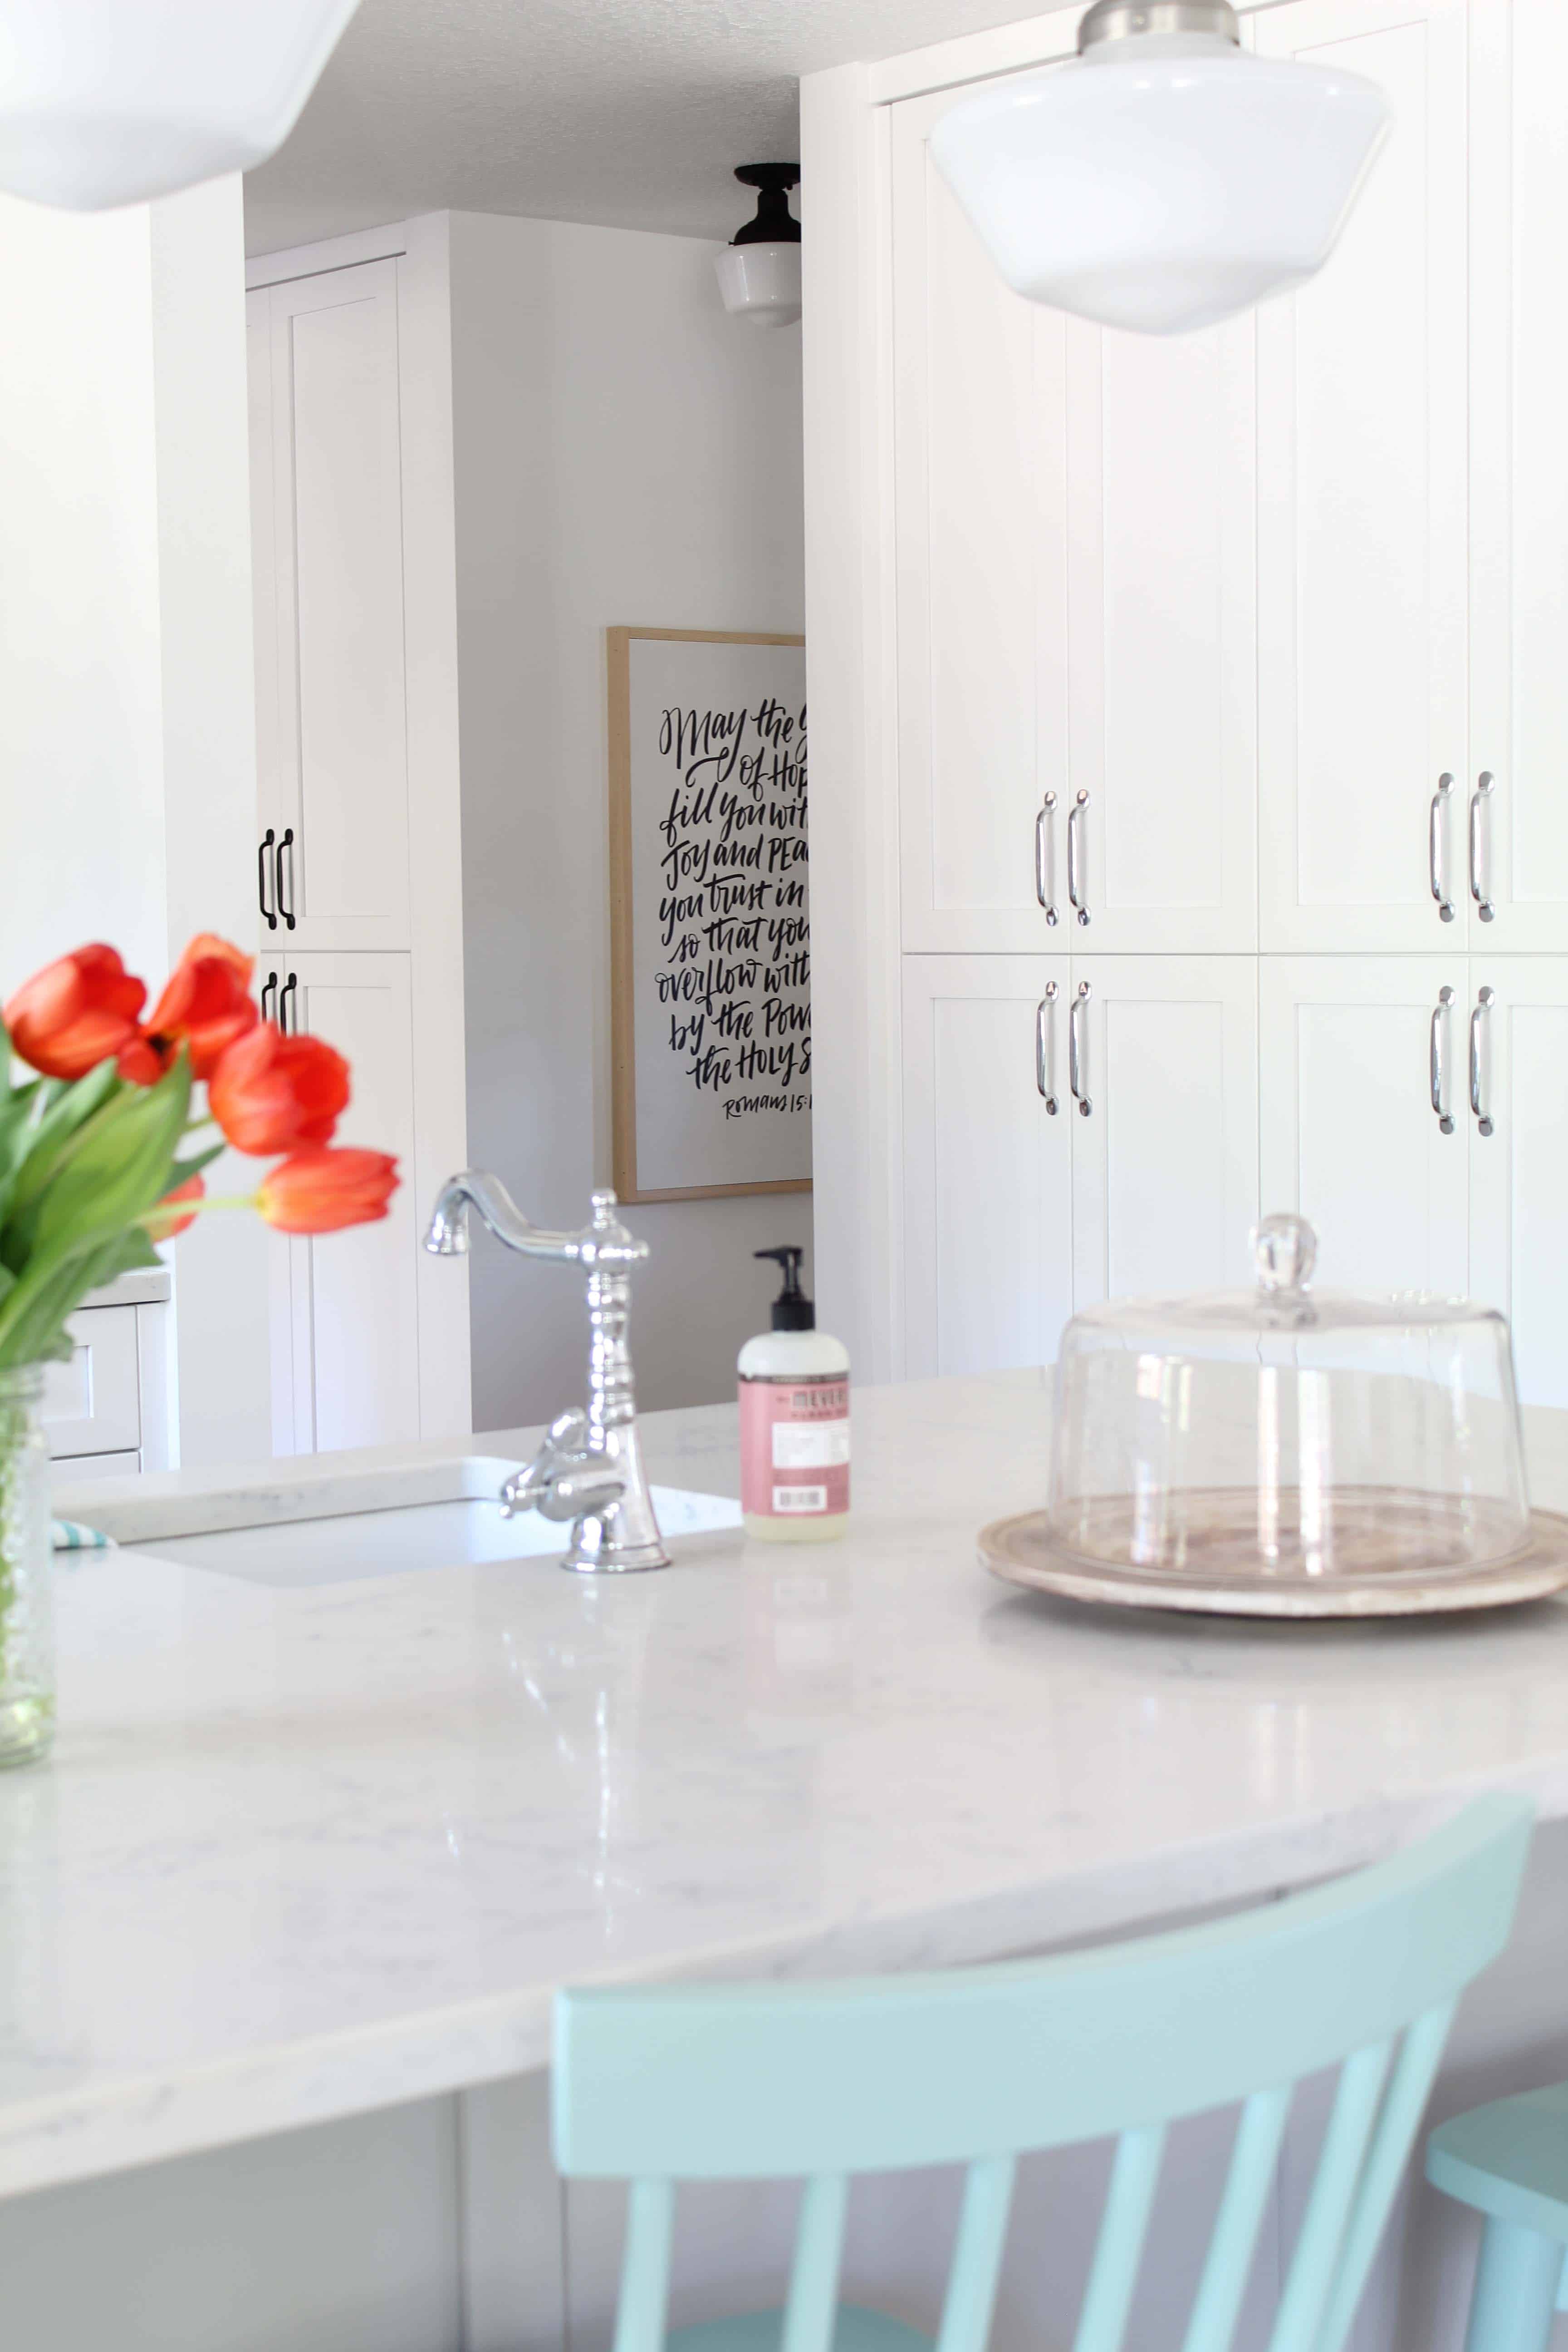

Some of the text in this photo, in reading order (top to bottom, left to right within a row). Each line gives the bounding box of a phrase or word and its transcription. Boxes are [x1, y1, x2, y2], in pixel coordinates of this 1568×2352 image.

[660, 708, 747, 788] May
[750, 698, 794, 749] the
[740, 746, 769, 802] of
[659, 782, 808, 848] fill you wit
[661, 833, 808, 891] Joy and PEa
[659, 873, 804, 946] you trust in
[667, 916, 810, 963] so that you
[655, 958, 763, 1017] overflow
[669, 1014, 705, 1056] by
[711, 1001, 754, 1040] the
[686, 1045, 732, 1091] the
[722, 1095, 787, 1120] Romans
